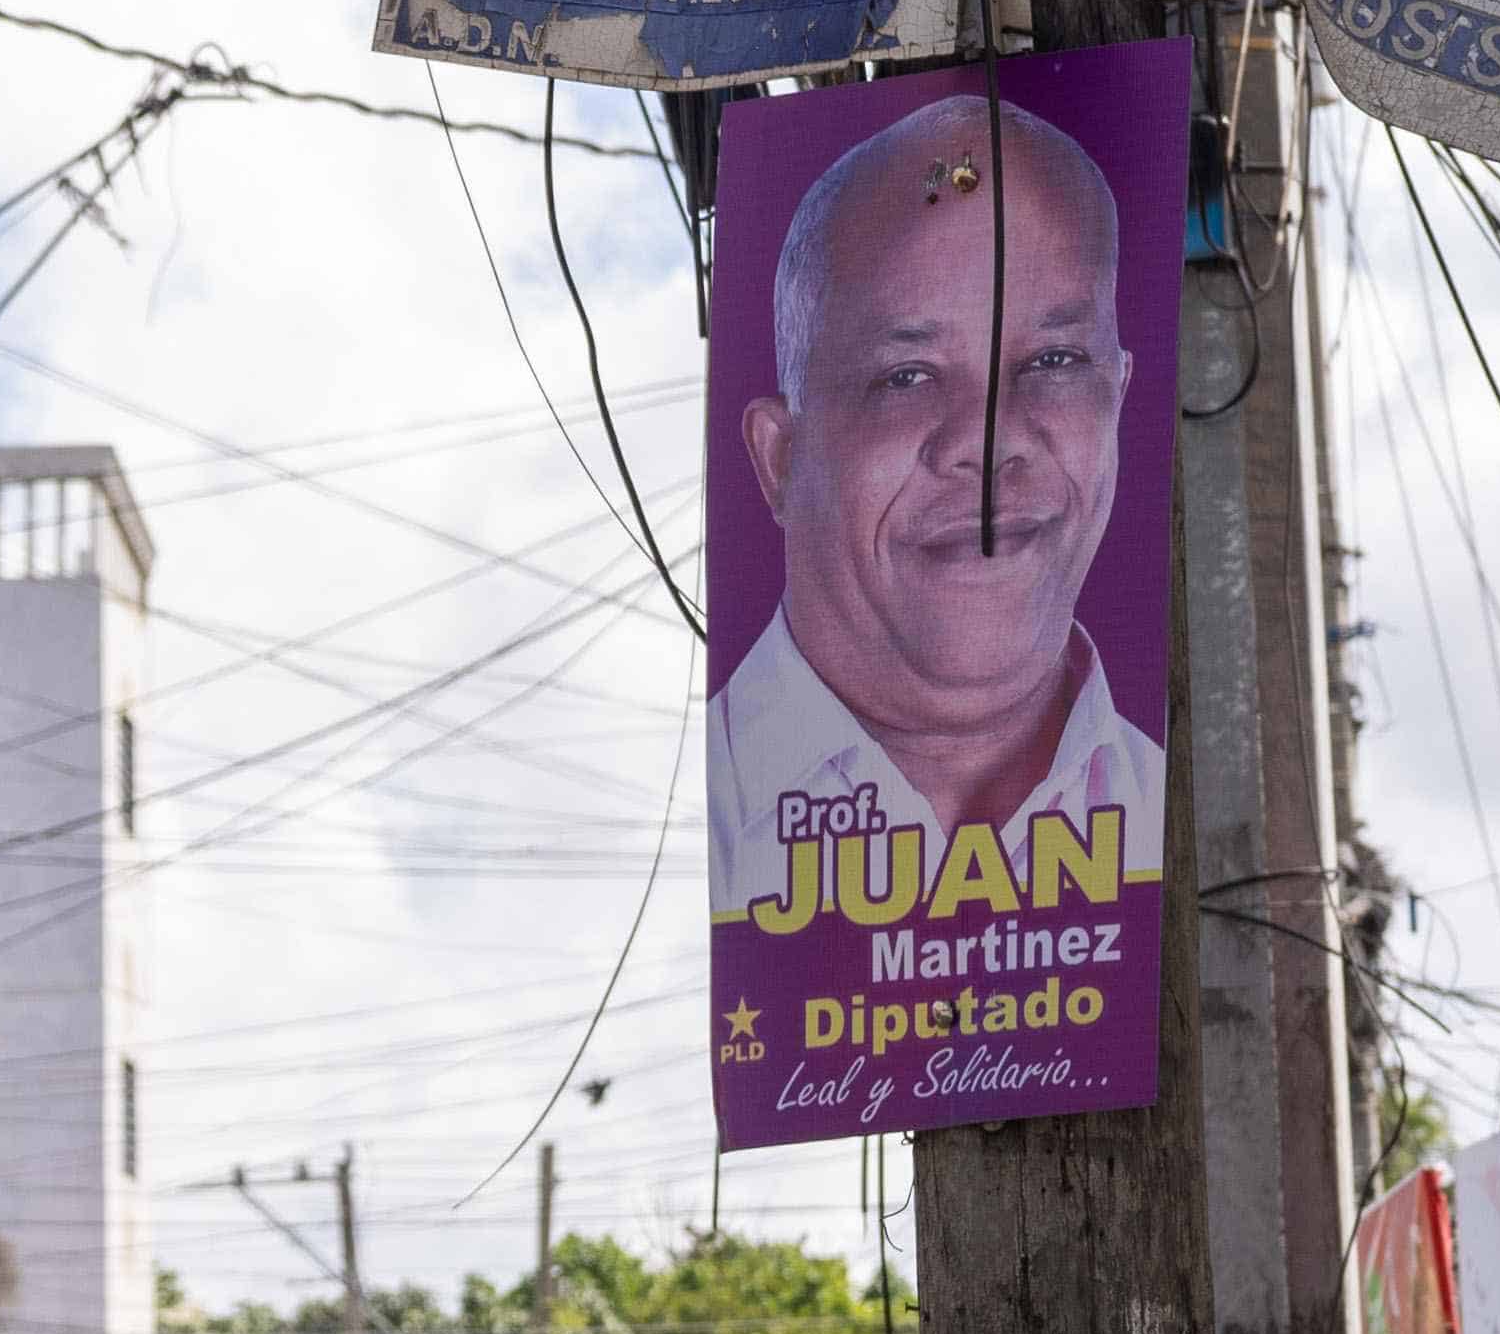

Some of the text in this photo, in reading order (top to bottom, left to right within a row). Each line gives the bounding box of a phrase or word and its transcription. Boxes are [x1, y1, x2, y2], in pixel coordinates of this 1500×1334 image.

[781, 786, 884, 839] Prof.
[751, 810, 1122, 935] JUAN
[871, 919, 1122, 983] Martinez
[803, 976, 1105, 1056] Diputado
[720, 1042, 766, 1064] PLD
[776, 1055, 866, 1111] Leal
[860, 1072, 895, 1123] y
